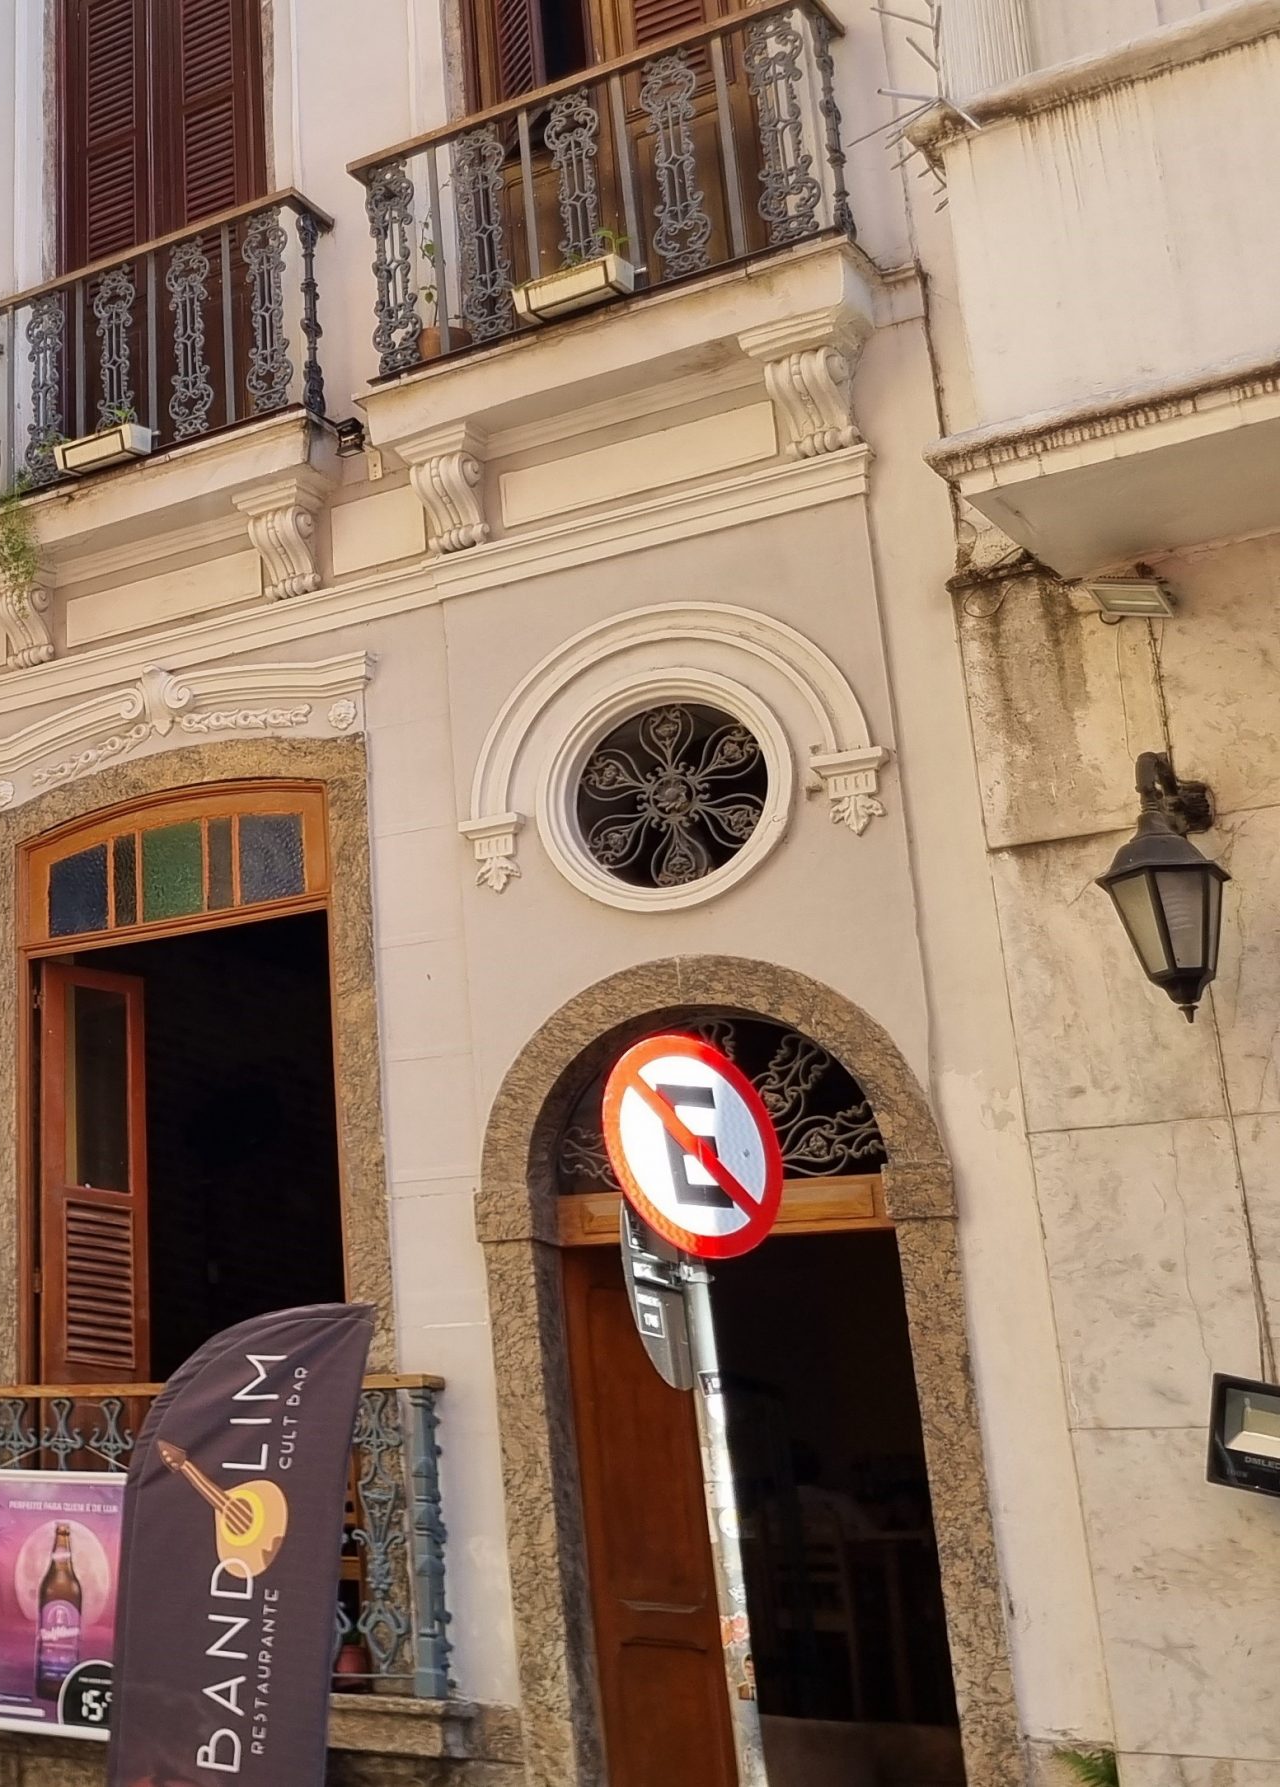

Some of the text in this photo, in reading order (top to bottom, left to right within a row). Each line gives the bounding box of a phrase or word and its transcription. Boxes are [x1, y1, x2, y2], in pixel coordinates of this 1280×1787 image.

[278, 1366, 309, 1470] CULT BAR
[250, 1588, 280, 1755] RESTAURANTE
